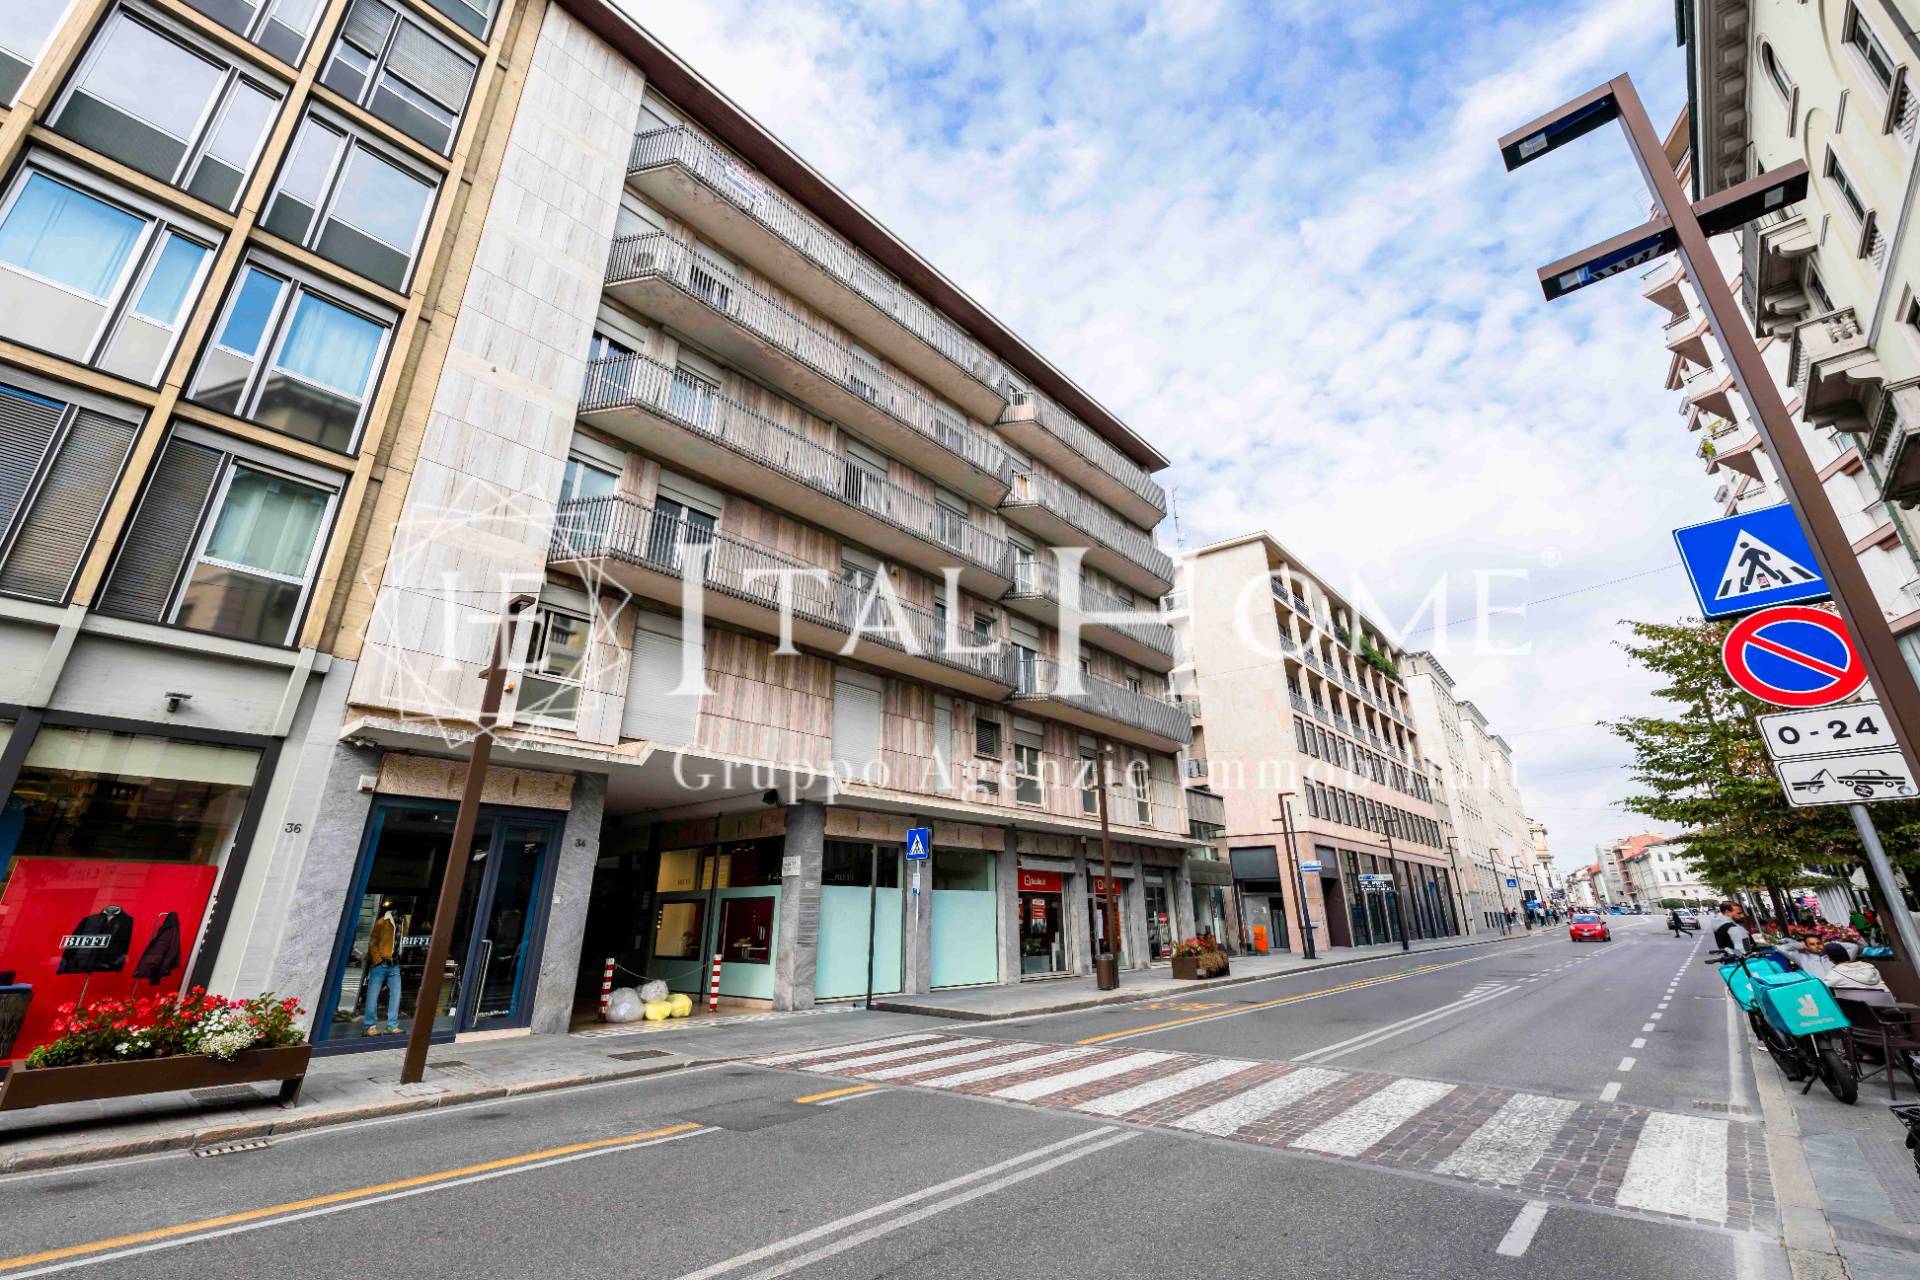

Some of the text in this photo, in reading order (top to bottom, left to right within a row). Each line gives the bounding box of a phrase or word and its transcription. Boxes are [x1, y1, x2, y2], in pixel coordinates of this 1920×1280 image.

[1827, 716, 1879, 739] 24
[284, 822, 303, 834] 36
[62, 935, 109, 947] BIFFI
[402, 936, 431, 946] BIFFI
